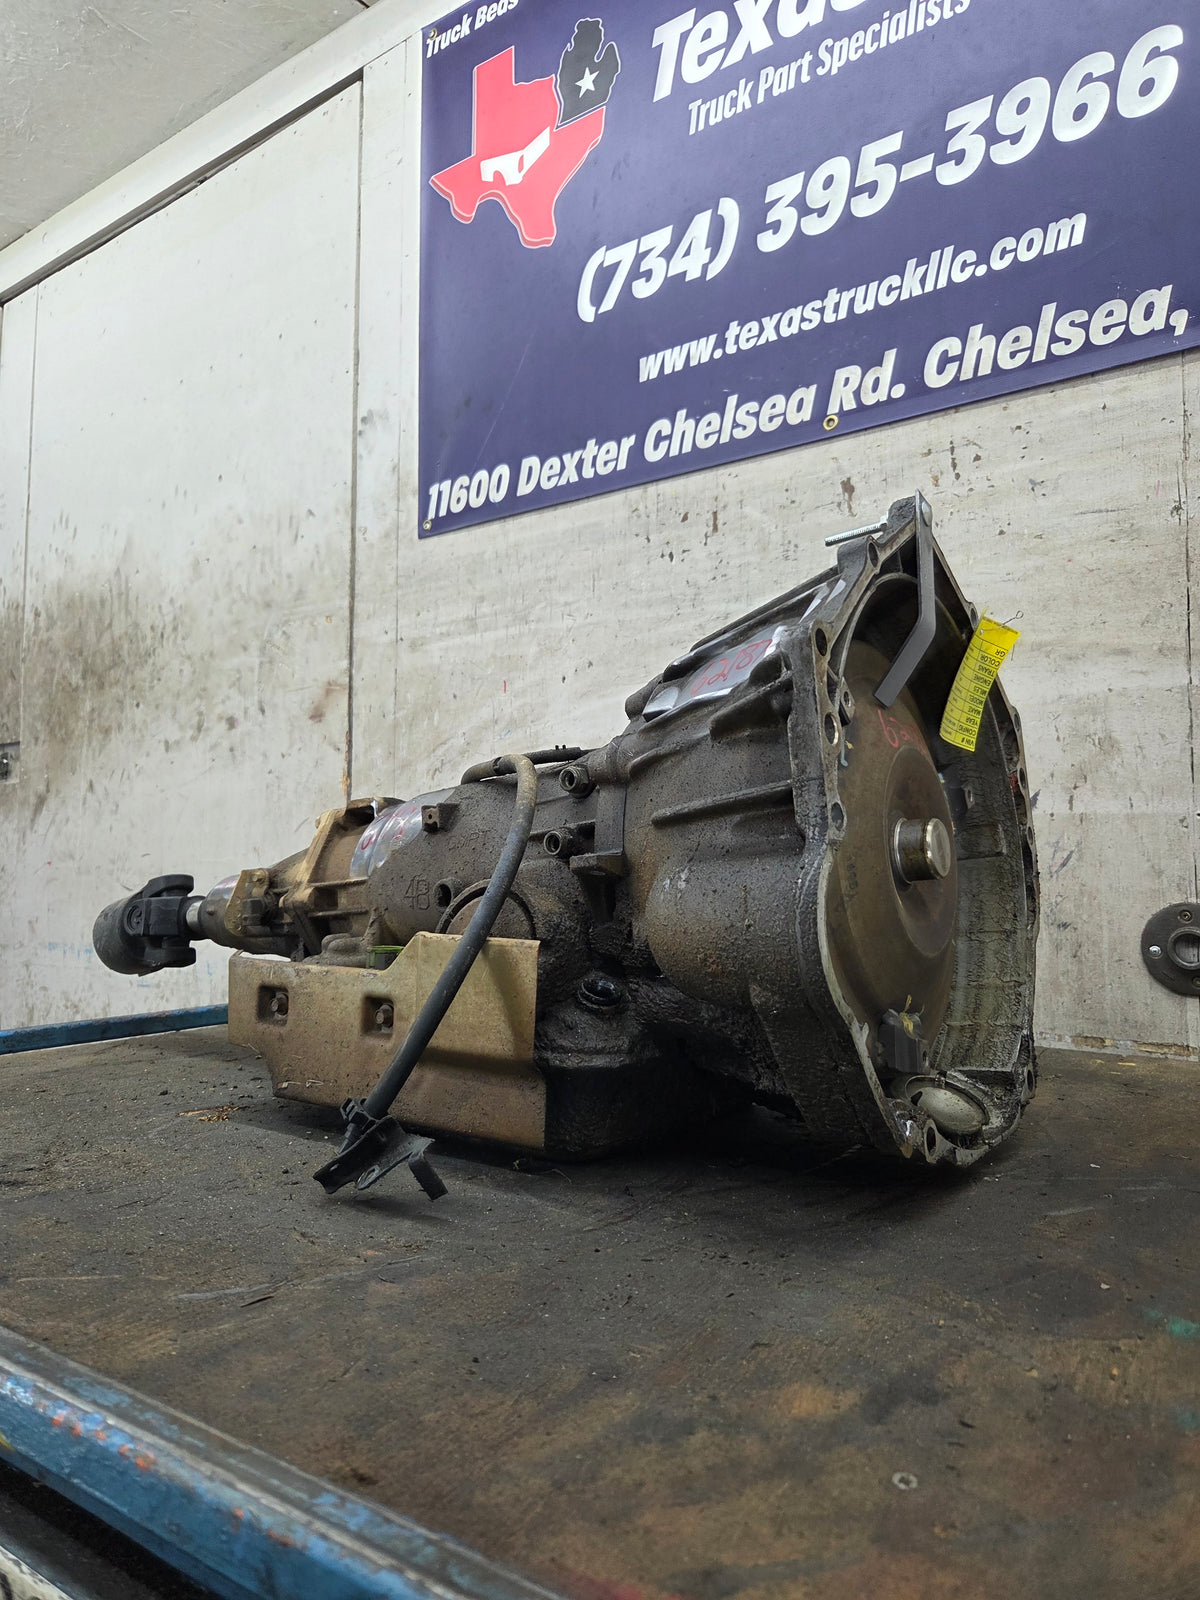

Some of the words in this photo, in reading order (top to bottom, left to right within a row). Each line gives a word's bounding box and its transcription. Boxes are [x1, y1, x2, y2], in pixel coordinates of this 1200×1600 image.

[426, 14, 472, 58] Truck
[651, 0, 868, 102] Texa
[688, 78, 754, 136] Truck
[757, 50, 813, 104] Part
[576, 197, 740, 323] (734)
[757, 24, 1184, 253] 395-3966
[638, 212, 1087, 383] www.texastruckllc.com
[426, 464, 510, 520] 11600
[516, 433, 636, 497] Dexter
[643, 385, 817, 463] Chelsea
[826, 348, 906, 415] Rd.
[923, 284, 1189, 389] Chelsea,
[978, 664, 996, 678] TRANS
[980, 653, 1001, 667] COLOR
[974, 673, 992, 687] ENGINE
[965, 716, 979, 727] YEAR
[967, 705, 981, 717] MAKE
[958, 723, 977, 737] CONFIG
